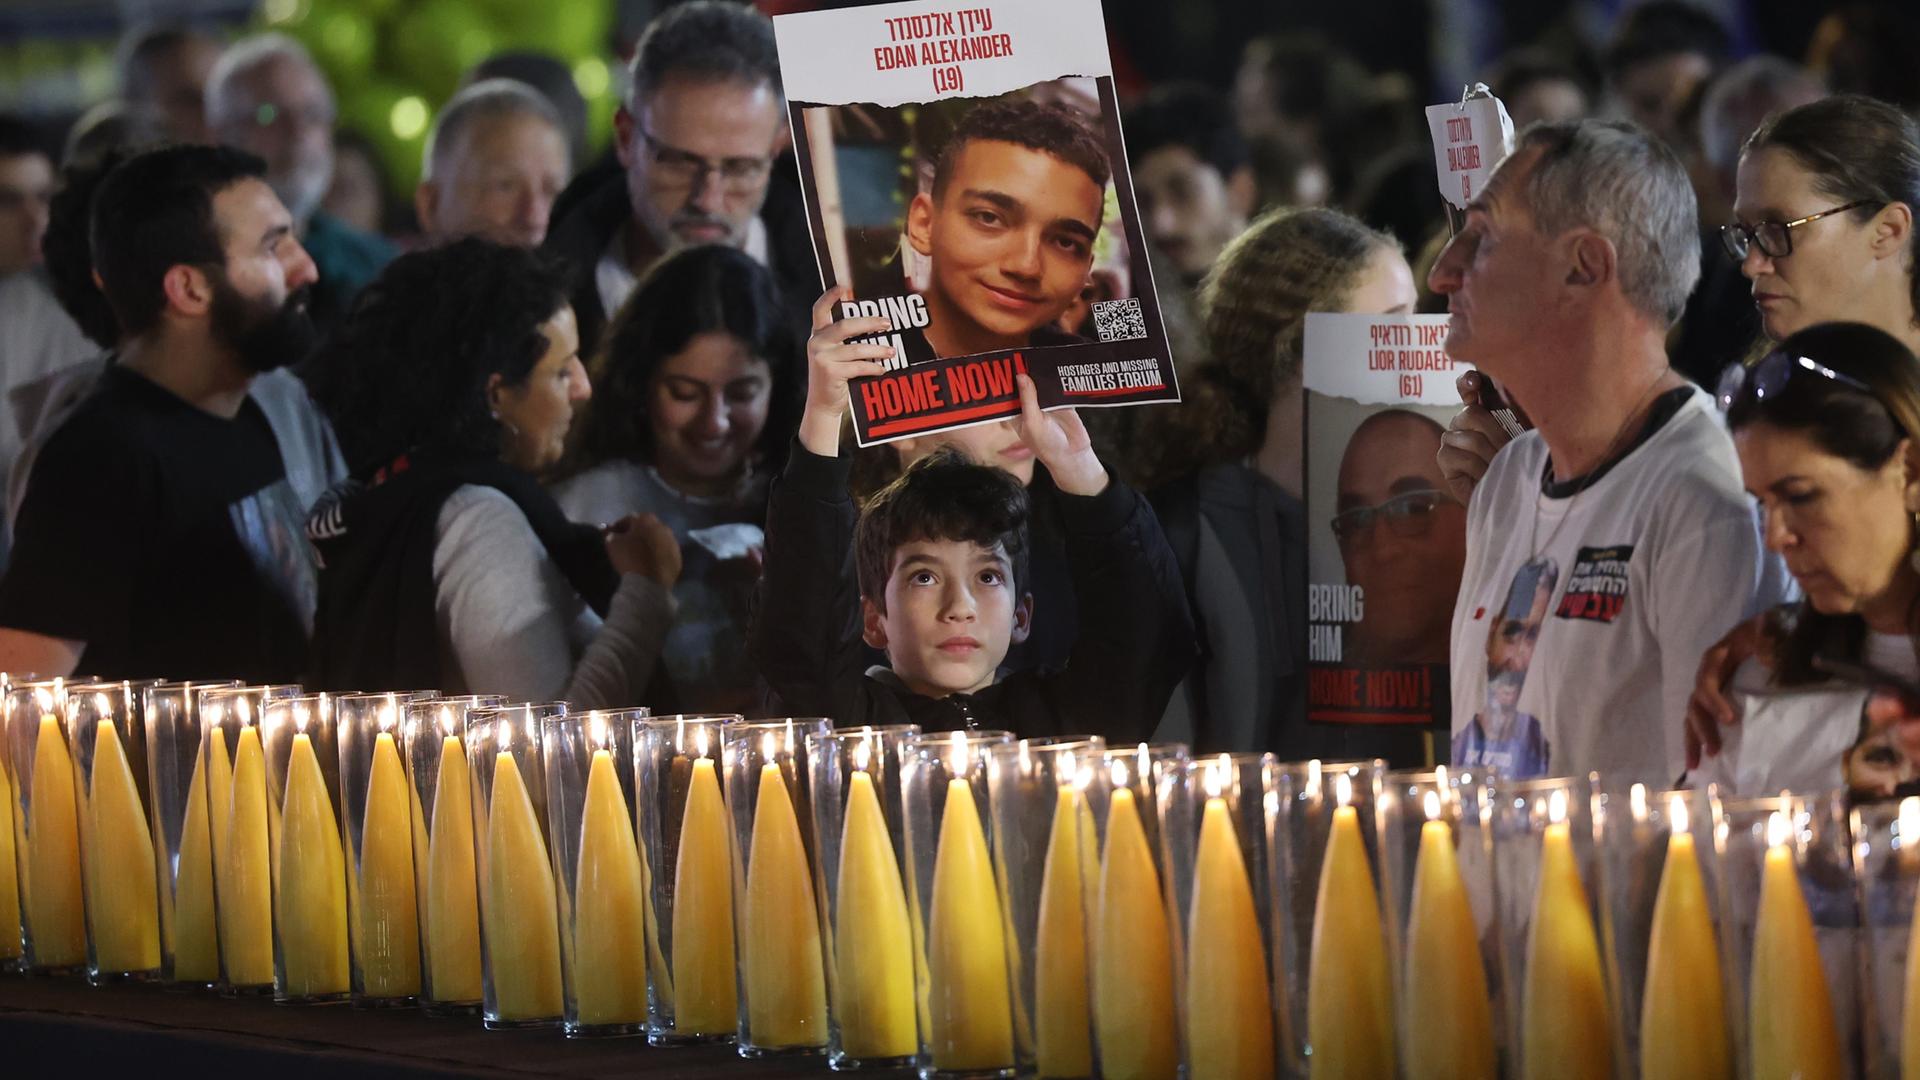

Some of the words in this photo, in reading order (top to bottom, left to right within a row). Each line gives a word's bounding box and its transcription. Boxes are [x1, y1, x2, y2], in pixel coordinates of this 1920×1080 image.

[884, 12, 954, 42] אלכסנדר
[957, 8, 993, 35] עידן
[874, 45, 917, 71] EDAN
[921, 33, 1013, 64] ALEXANDER
[932, 66, 964, 95] (19)
[1370, 324, 1411, 347] רודאיף
[1057, 363, 1101, 377] HOSTAGES
[1102, 361, 1120, 375] AND
[1120, 358, 1159, 372] MISSING
[1369, 350, 1395, 371] LIOR
[1060, 373, 1116, 392] FAMILIES
[1117, 369, 1163, 389] FORUM
[1399, 374, 1423, 398] (61)
[860, 370, 945, 421] HOME
[1309, 584, 1364, 622] BRING
[1309, 625, 1342, 662] HIM
[1310, 669, 1361, 707] HOME
[1367, 667, 1433, 708] NOW!
